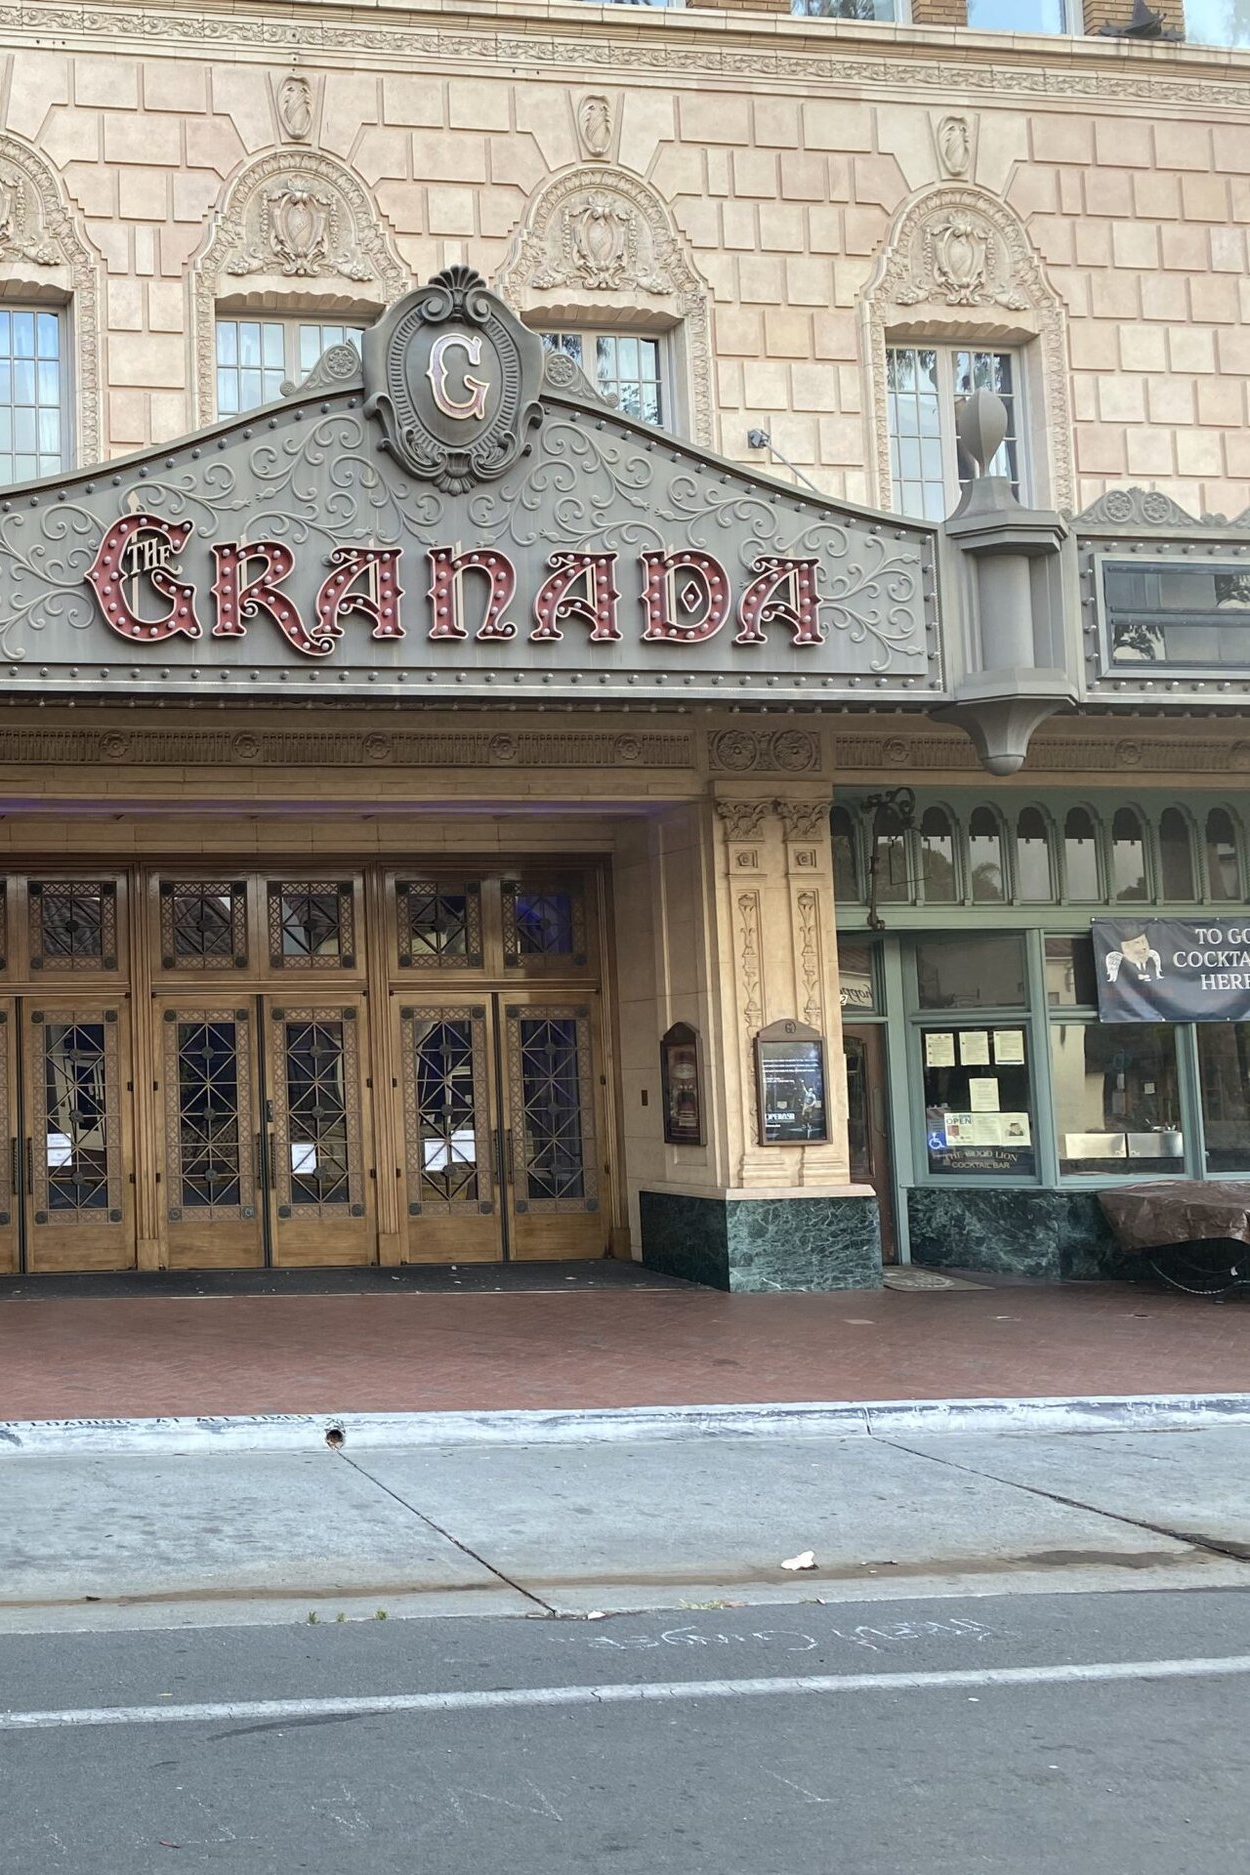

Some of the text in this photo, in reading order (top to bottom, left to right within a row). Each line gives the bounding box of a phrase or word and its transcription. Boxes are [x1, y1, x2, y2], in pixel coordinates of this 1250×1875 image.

[426, 332, 490, 420] G
[126, 537, 183, 575] THE
[84, 510, 825, 658] GRANADA
[1195, 928, 1223, 945] TO
[946, 1117, 972, 1125] OPEN
[952, 1161, 1010, 1169] COCKTAIL BAR
[996, 1151, 1017, 1162] LION
